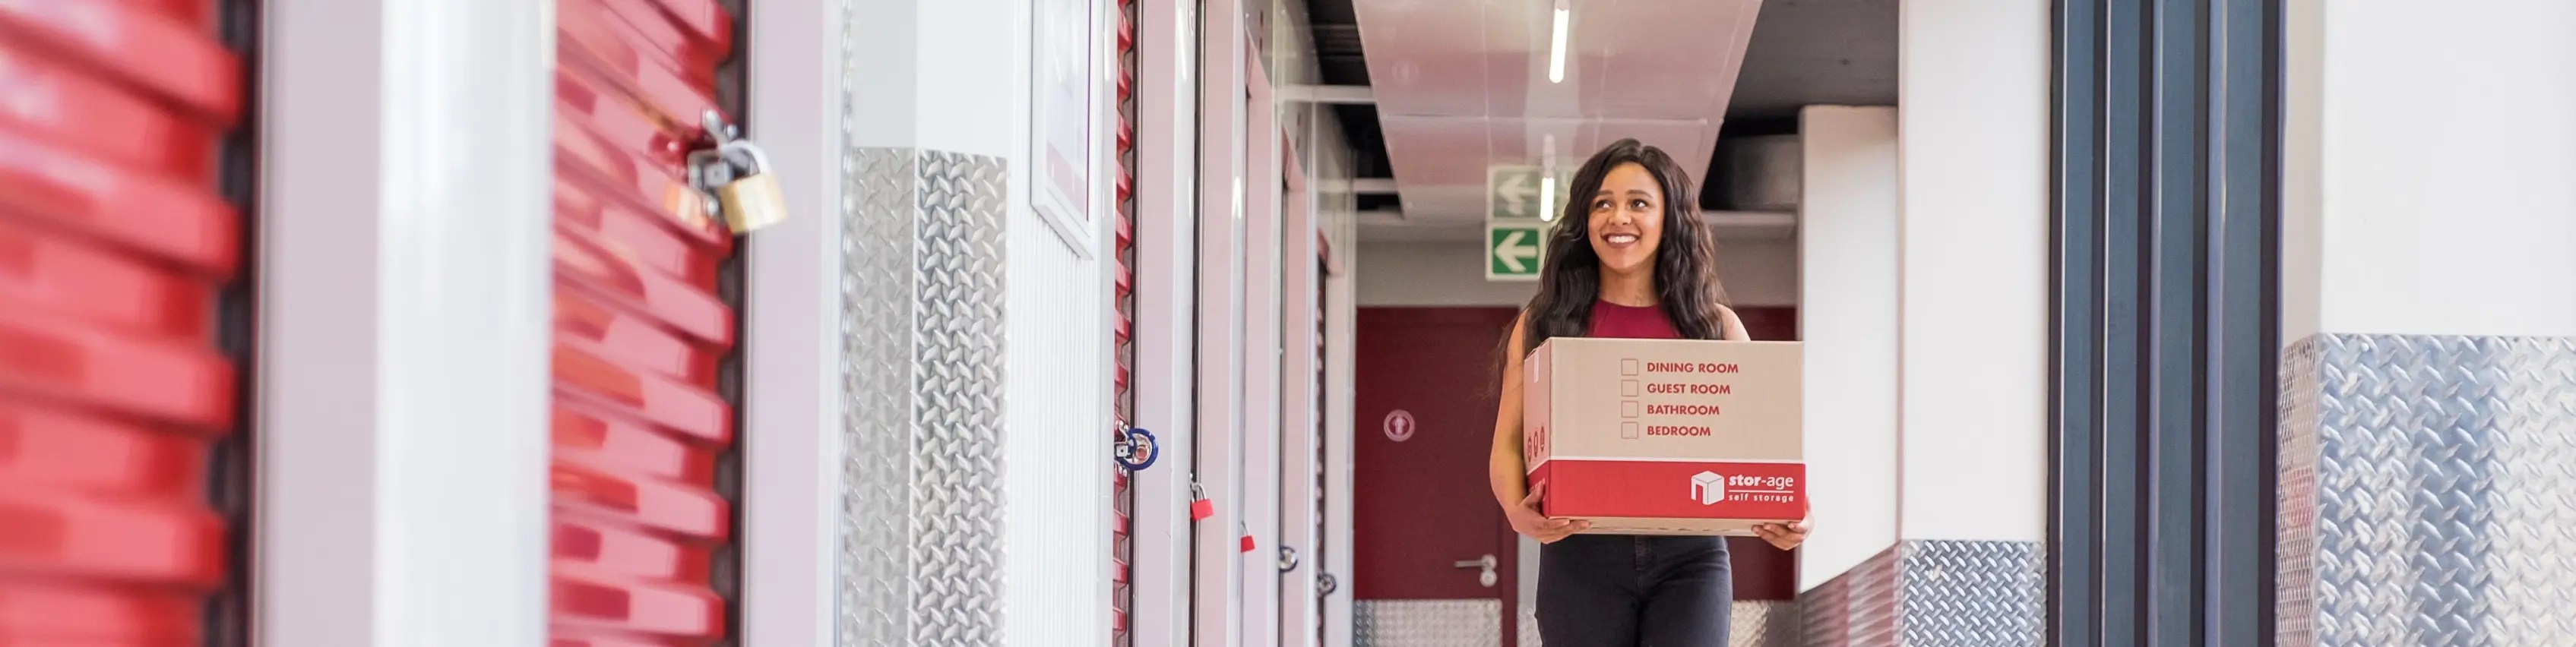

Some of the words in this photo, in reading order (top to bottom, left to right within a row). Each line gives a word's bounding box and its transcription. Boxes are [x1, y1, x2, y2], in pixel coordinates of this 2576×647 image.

[1647, 362, 1695, 373] DINING
[1698, 363, 1739, 374] ROOM
[1647, 383, 1686, 394] GUEST
[1690, 383, 1731, 395] ROOM
[1647, 404, 1720, 415] BATHROOM
[1647, 425, 1711, 437] BEDROOM
[1729, 474, 1794, 490] stor-age
[1729, 493, 1748, 501] self
[1753, 494, 1794, 503] storage
